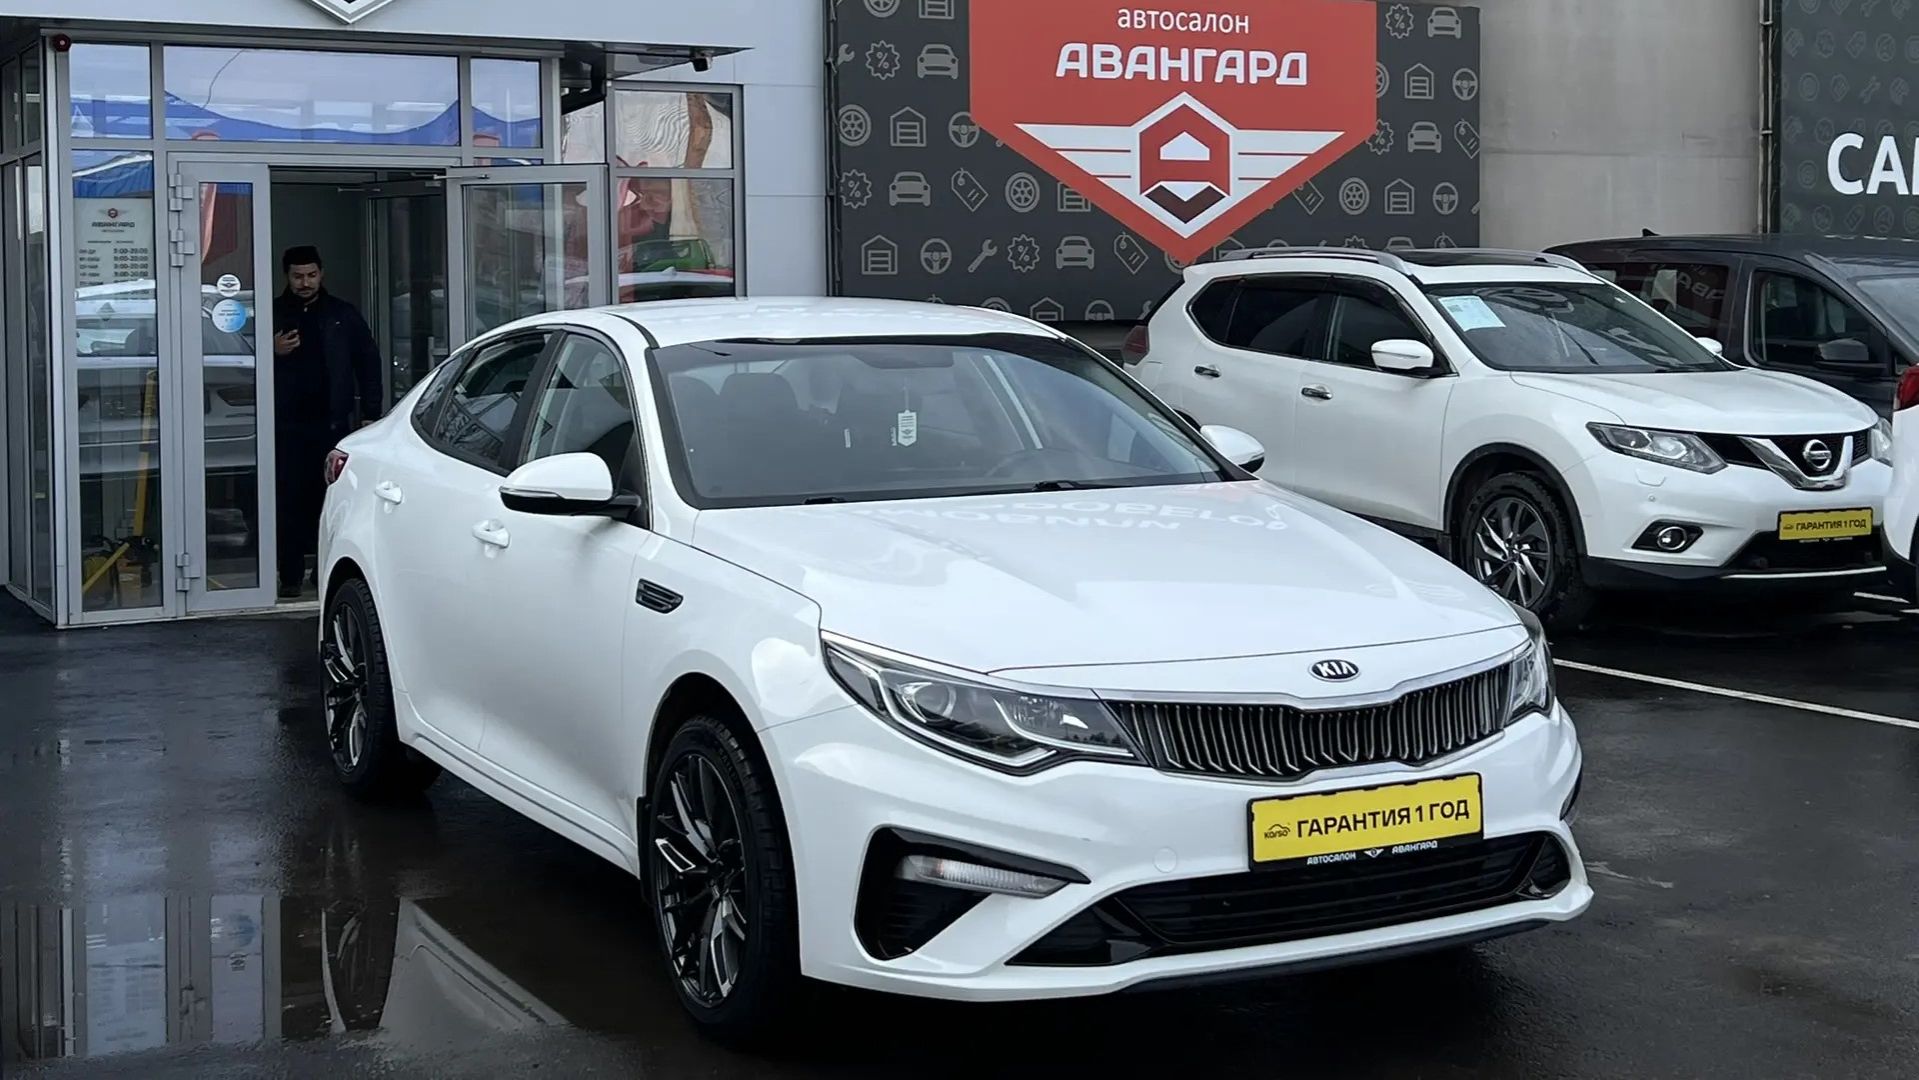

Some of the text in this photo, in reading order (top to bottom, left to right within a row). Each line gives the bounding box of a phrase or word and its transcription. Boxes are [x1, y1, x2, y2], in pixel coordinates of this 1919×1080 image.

[1117, 8, 1249, 34] автосалон
[1055, 42, 1308, 86] АВАНГАРД
[1827, 132, 1919, 195] СА
[1796, 520, 1843, 531] ГАРАНТИЯ
[1844, 520, 1848, 528] 1
[1849, 519, 1867, 528] ГОД
[1316, 661, 1357, 677] KIA
[1297, 799, 1470, 838] ГАРАНТИЯ 1 ГОД
[1306, 840, 1438, 865] АВТОСАЛОН АВАНГАРД
